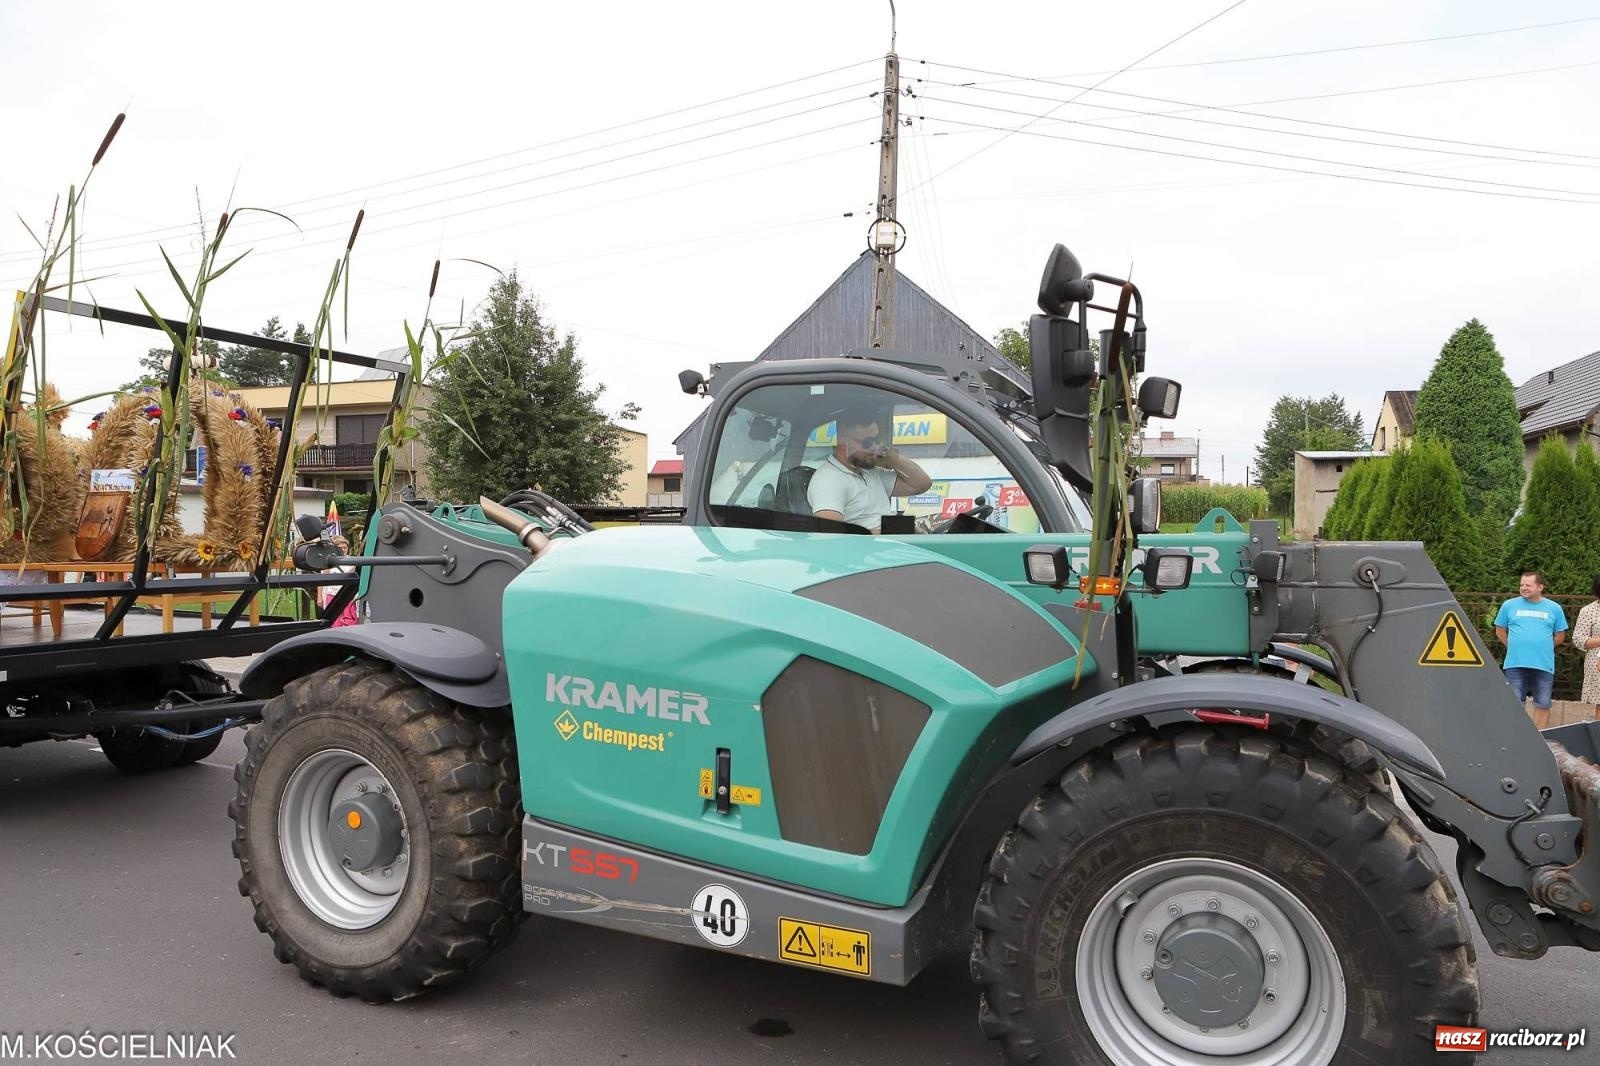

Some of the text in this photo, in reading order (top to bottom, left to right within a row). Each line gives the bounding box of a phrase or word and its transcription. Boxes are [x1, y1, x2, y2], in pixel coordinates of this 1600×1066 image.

[545, 673, 711, 725] KRAMER
[582, 720, 665, 752] Chempest
[524, 893, 550, 906] PRO
[702, 894, 736, 937] 40
